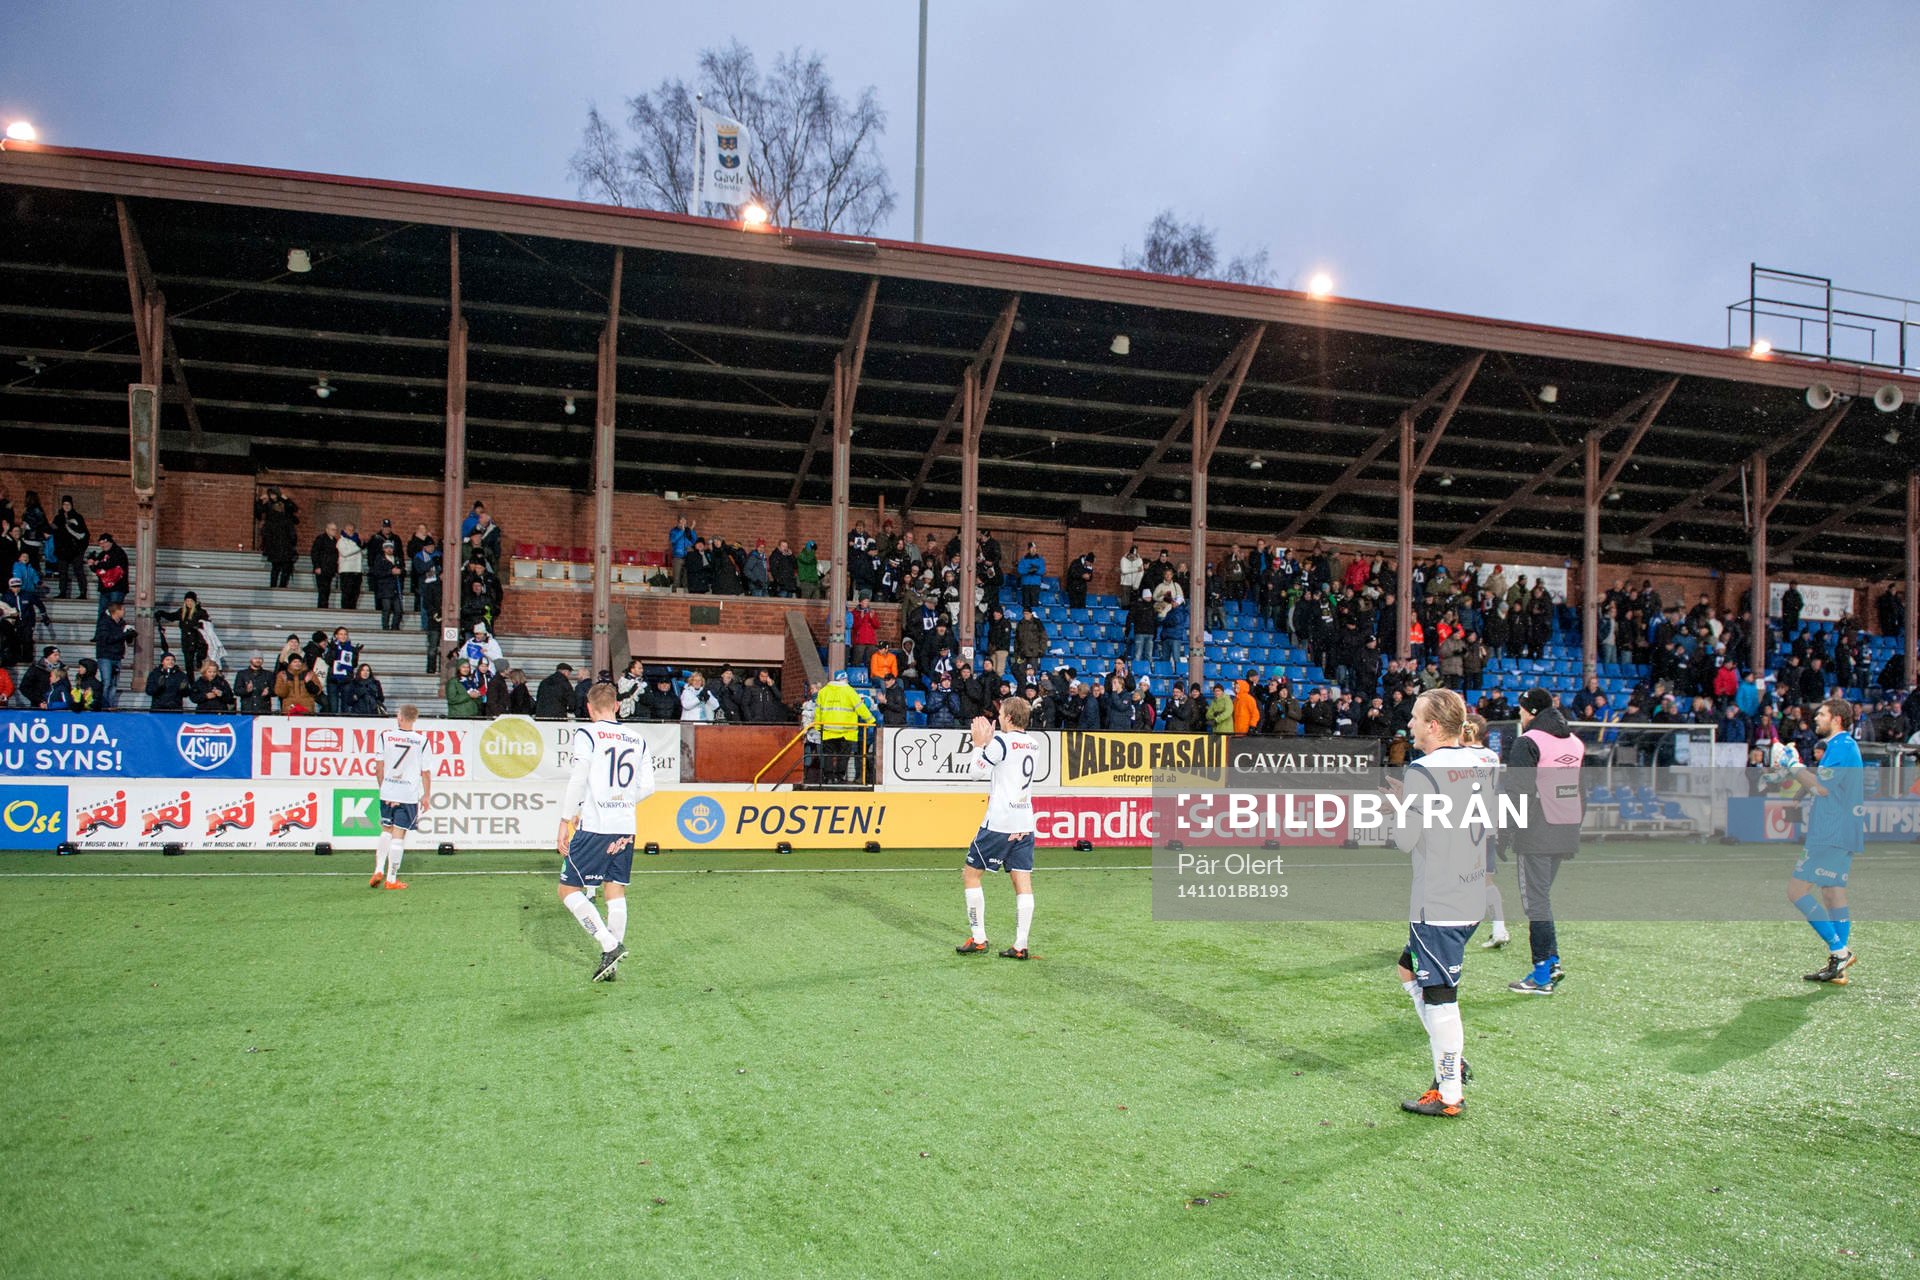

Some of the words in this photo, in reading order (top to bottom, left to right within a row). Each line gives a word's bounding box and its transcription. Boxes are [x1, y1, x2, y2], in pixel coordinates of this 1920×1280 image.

[8, 718, 118, 748] NÖJDA,
[0, 749, 24, 770] U
[35, 749, 122, 771] SYNS!
[184, 737, 228, 762] 4Sign
[394, 744, 411, 769] 7
[1066, 732, 1143, 781] VALBO
[1150, 735, 1222, 782] FASAD
[437, 759, 466, 777] AB
[604, 747, 634, 788] 16
[1022, 755, 1034, 790] 9
[1234, 752, 1369, 775] CAVALIERE
[1113, 773, 1164, 785] entreprenad
[1166, 773, 1177, 783] ab
[421, 792, 557, 811] ONTORS-
[4, 800, 61, 834] Ost
[416, 816, 521, 835] CENTER
[736, 805, 886, 835] POSTEN!
[1034, 801, 1161, 839] candic
